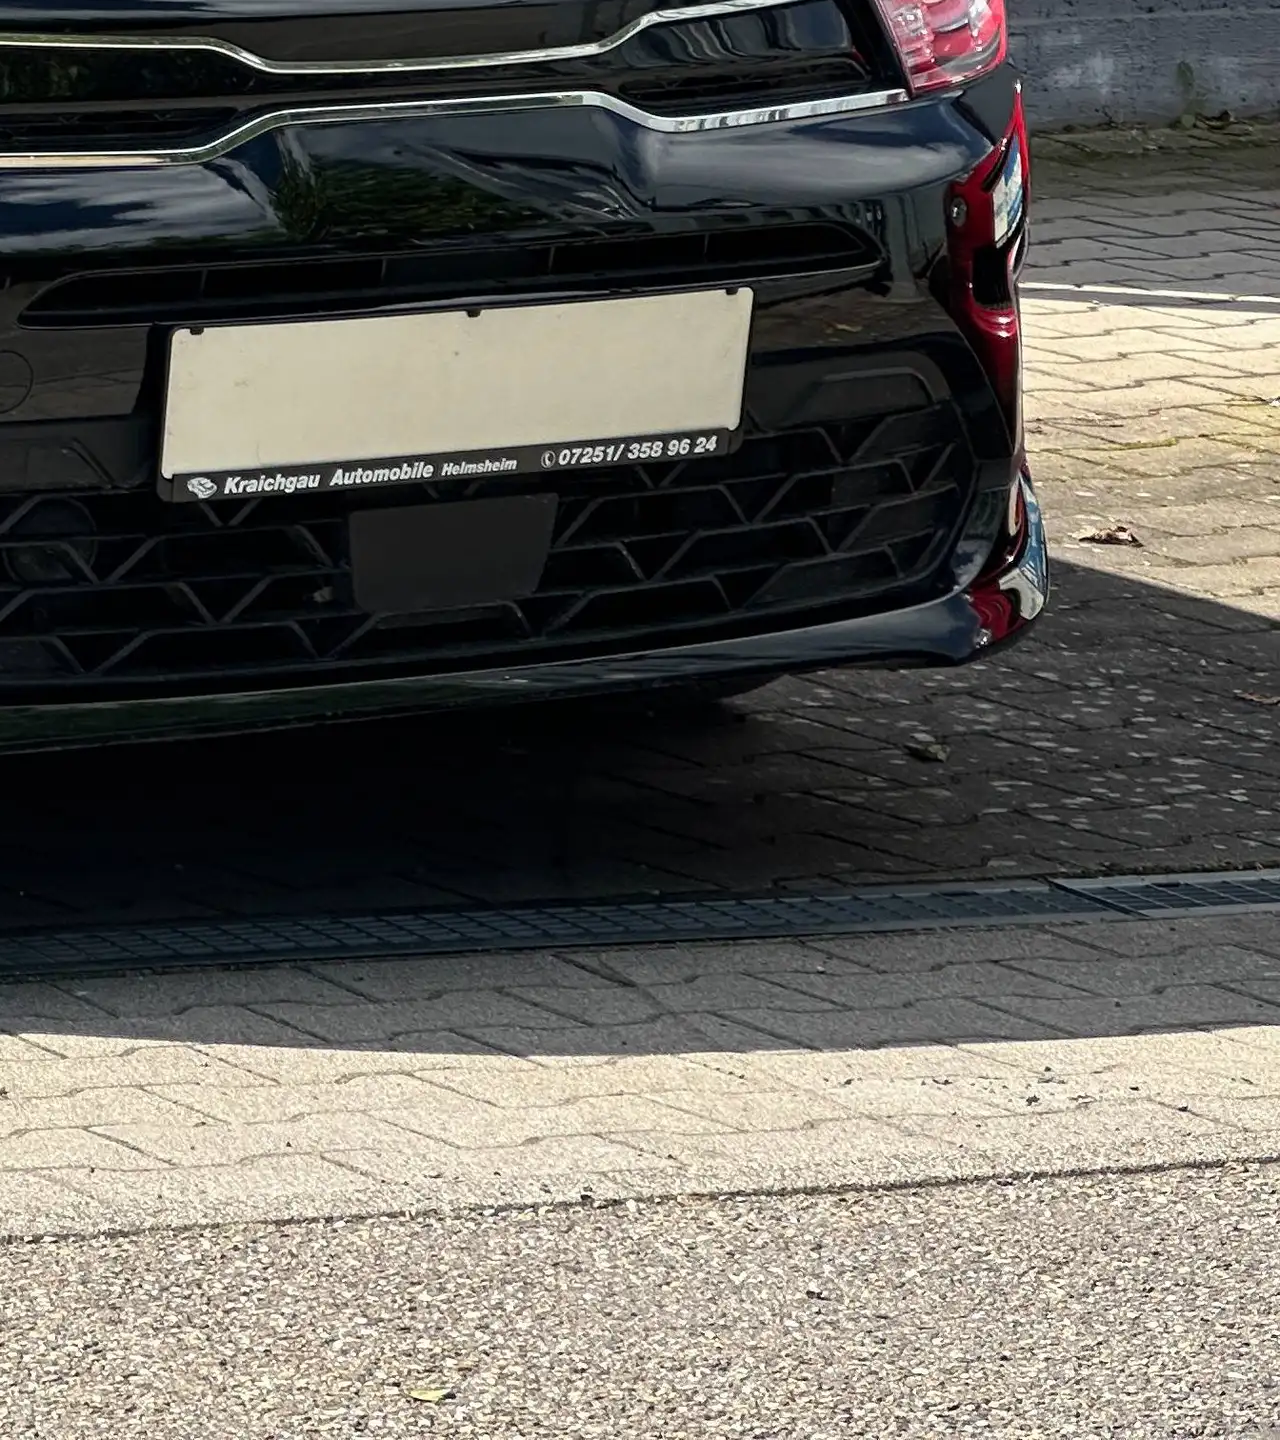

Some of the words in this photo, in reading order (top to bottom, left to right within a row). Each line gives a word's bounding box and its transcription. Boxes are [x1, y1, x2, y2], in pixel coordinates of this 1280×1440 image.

[558, 444, 625, 465] 07251/
[627, 441, 664, 459] 358
[667, 438, 691, 456] 96
[693, 435, 718, 453] 24
[224, 473, 321, 494] Kraichgau
[329, 462, 434, 486] Automobile
[441, 457, 518, 477] Helmsheim
